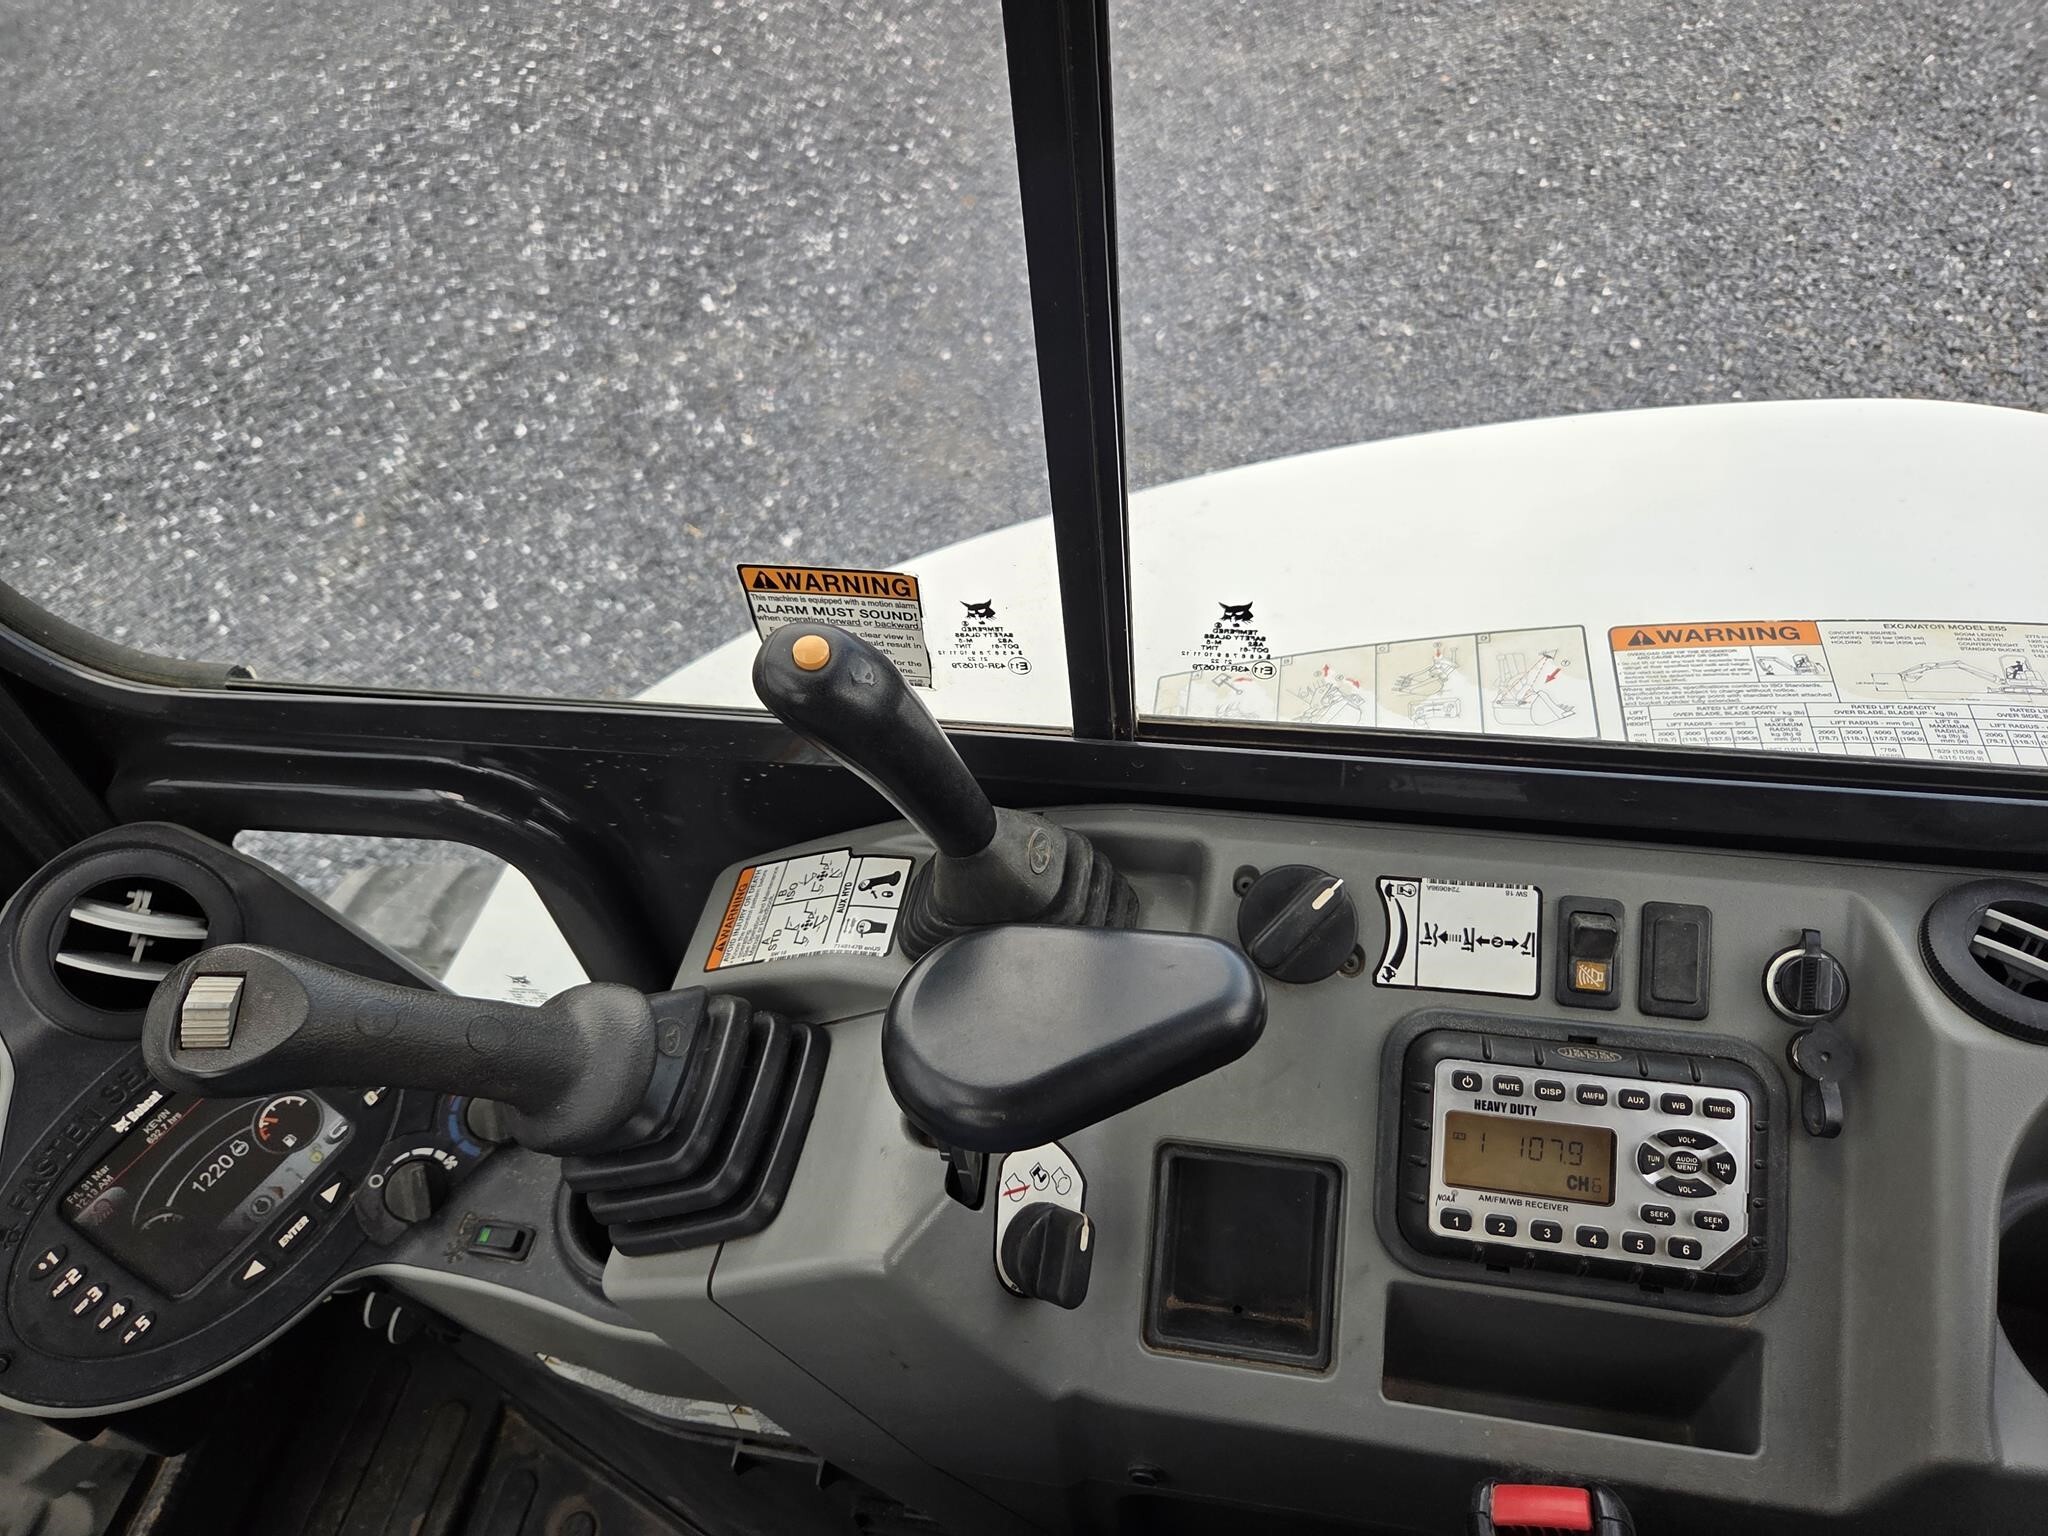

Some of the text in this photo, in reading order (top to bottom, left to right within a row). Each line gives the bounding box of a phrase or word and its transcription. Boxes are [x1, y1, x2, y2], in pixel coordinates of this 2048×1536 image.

[776, 572, 911, 597] WARNING
[750, 593, 767, 601] This
[768, 595, 799, 603] machine
[808, 597, 842, 606] equipped
[844, 598, 860, 606] with
[867, 600, 893, 608] motion
[895, 601, 918, 610] alarm.
[757, 604, 918, 621] ALARM MUST SOUND!
[826, 618, 860, 627] forward
[875, 621, 919, 630] backward
[1656, 627, 1800, 643] WARNING
[887, 641, 911, 649] result
[778, 889, 787, 897] B
[785, 882, 798, 900] ISO
[836, 882, 852, 914] AUX HYD
[720, 882, 748, 941] WARNING
[723, 869, 762, 962] AVOID INJURY OR DEATH
[761, 937, 772, 945] A
[768, 929, 782, 951] STD
[1498, 1082, 1520, 1091] MUTE
[1540, 1087, 1562, 1096] DISP
[1582, 1092, 1605, 1100] AM/FM
[1627, 1096, 1645, 1105] AUX
[126, 1090, 163, 1122] Bobcat
[1474, 1099, 1538, 1117] HEAVY DUTY
[1671, 1101, 1686, 1110] WB
[1709, 1105, 1732, 1114] TIMER
[142, 1108, 171, 1134] KEVIN
[167, 1112, 182, 1125] hrs
[1520, 1136, 1584, 1166] 107.9
[1647, 1155, 1660, 1163] TUN
[1676, 1156, 1698, 1164] AUDIO
[91, 1165, 110, 1181] Mar
[192, 1155, 234, 1192] 1220
[1676, 1164, 1697, 1172] MENU
[1716, 1163, 1731, 1171] TUN
[98, 1174, 113, 1190] AM
[1436, 1193, 1456, 1204] NOAA
[1478, 1195, 1569, 1212] AM/FM/WB RECEIVER
[1453, 1217, 1459, 1227] 1
[1703, 1216, 1723, 1224] SEEK
[278, 1215, 310, 1248] ENTER
[1498, 1222, 1506, 1233] 2
[1543, 1228, 1551, 1238] 3
[1590, 1235, 1597, 1245] 4
[1637, 1240, 1644, 1250] 5
[1683, 1245, 1690, 1255] 6
[47, 1251, 59, 1265] 1
[65, 1268, 82, 1285] 2
[86, 1286, 103, 1302] 3
[112, 1302, 125, 1319] 4
[135, 1315, 151, 1332] 5
